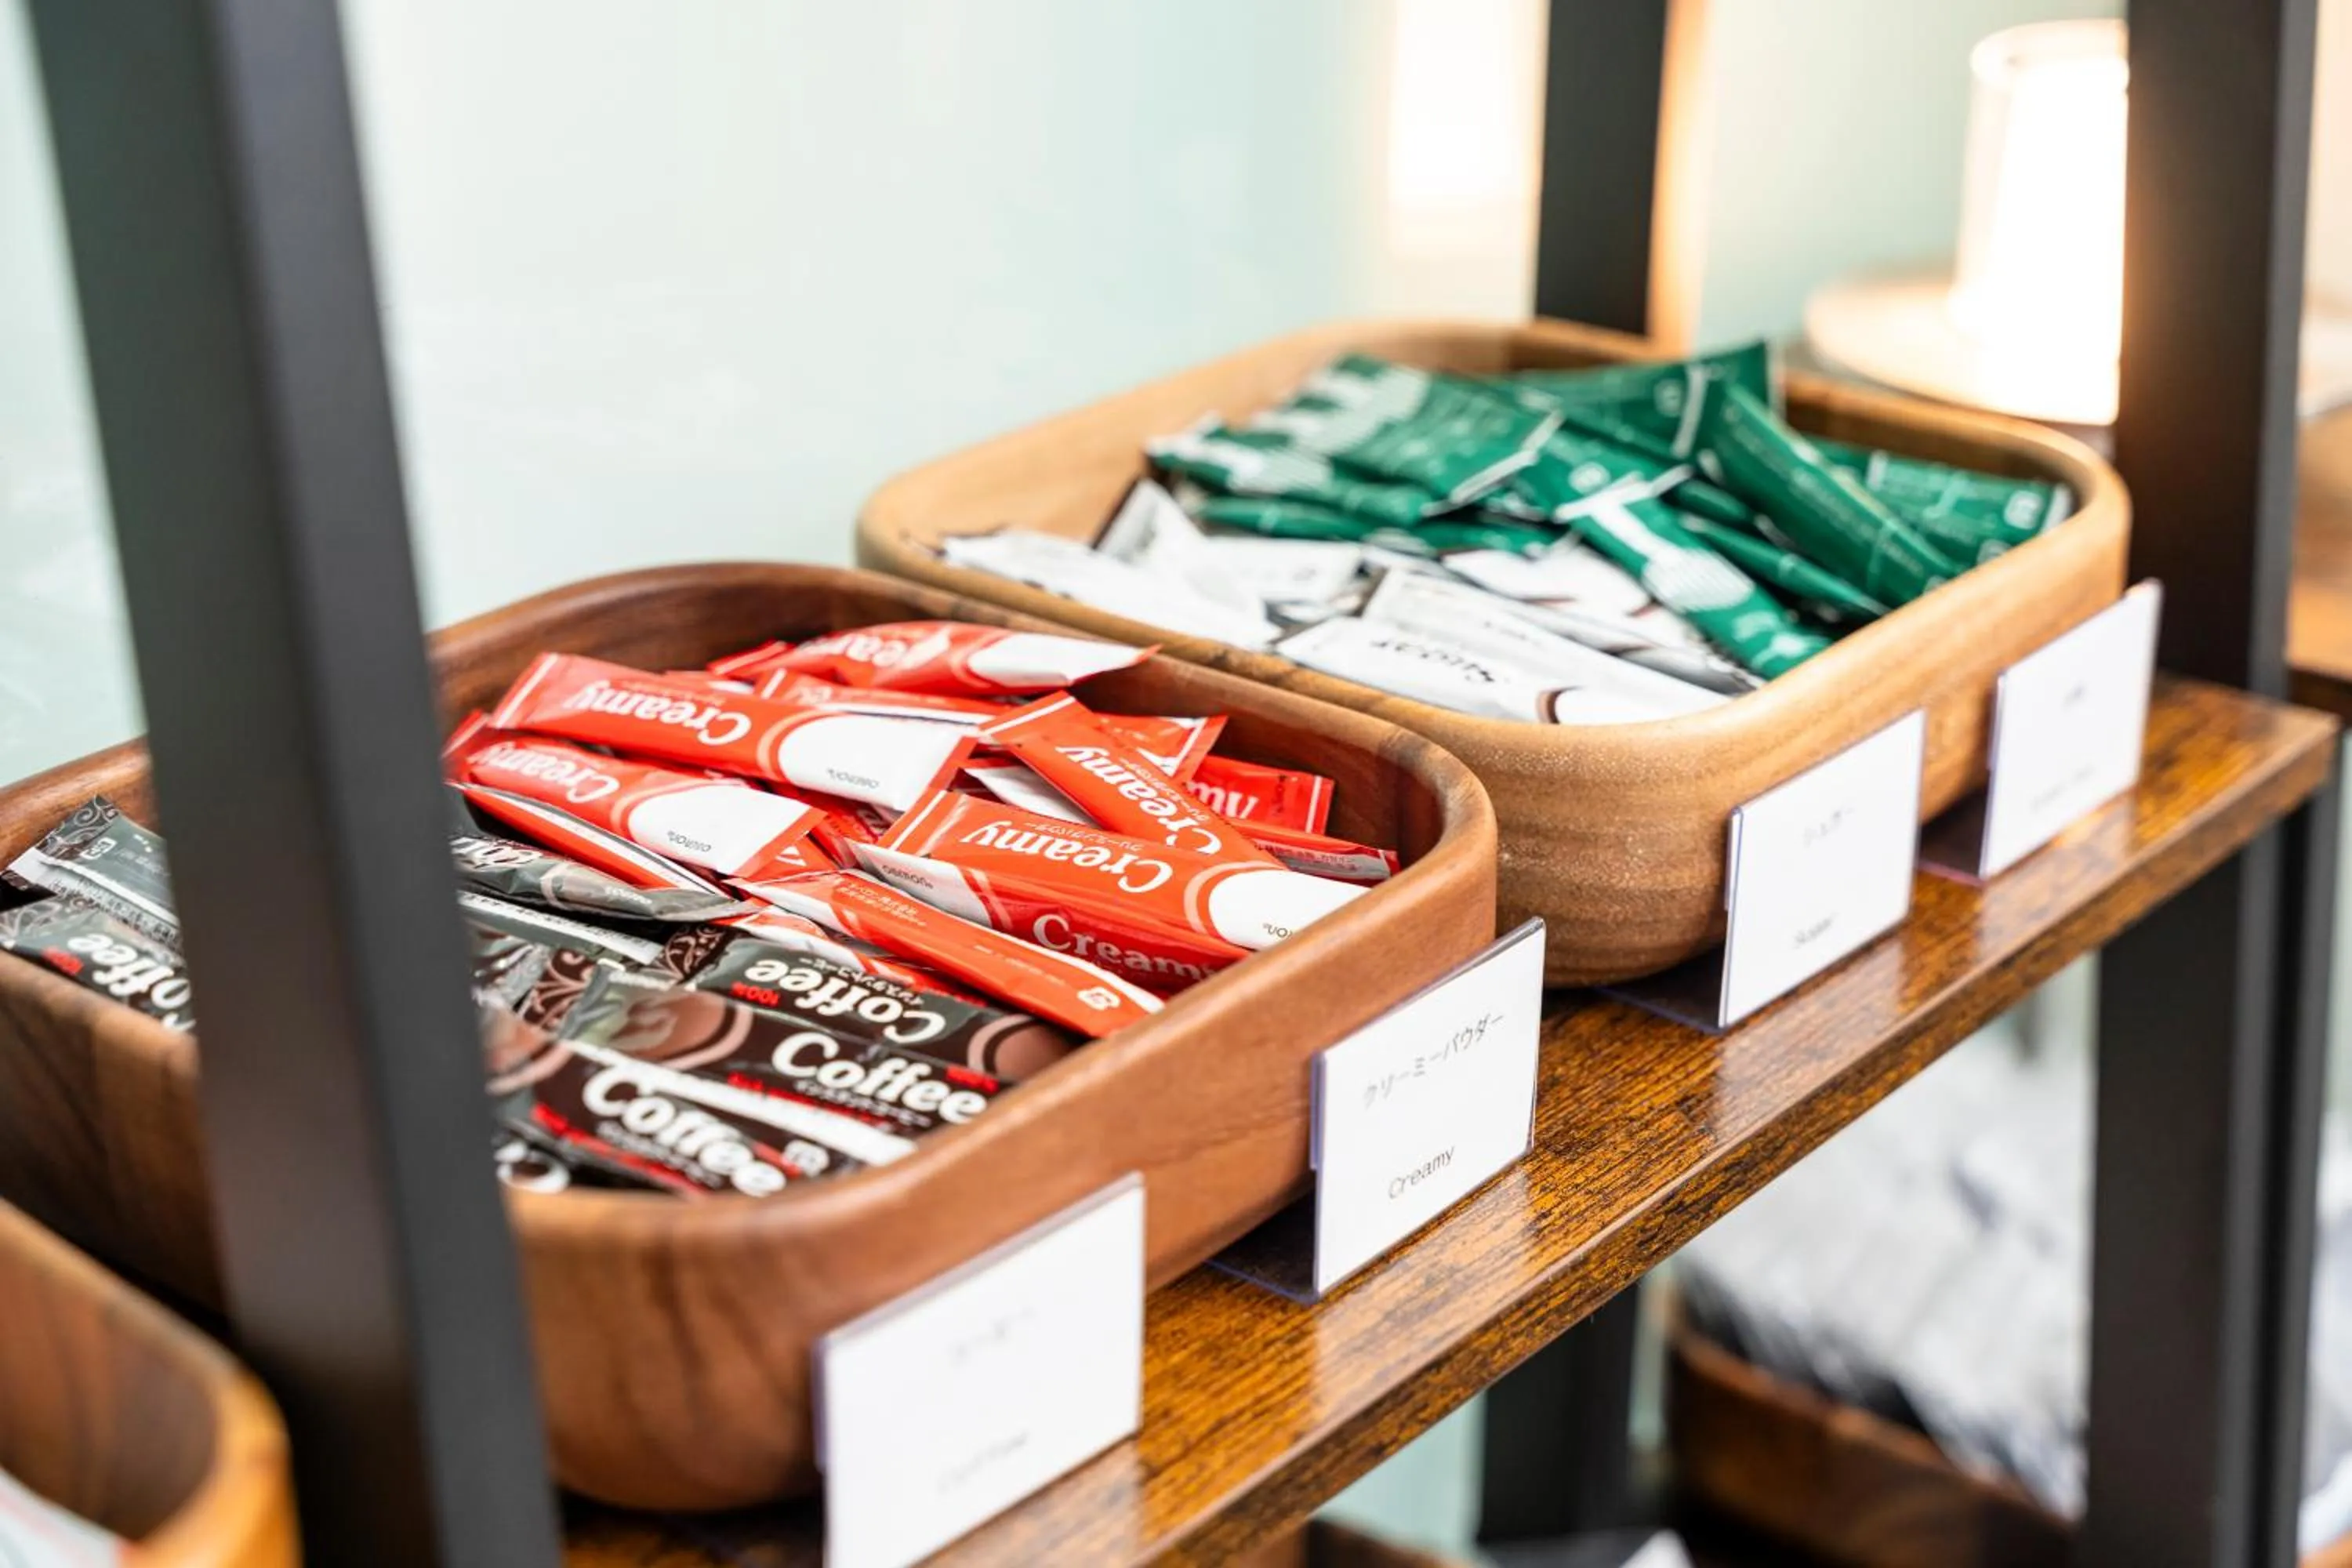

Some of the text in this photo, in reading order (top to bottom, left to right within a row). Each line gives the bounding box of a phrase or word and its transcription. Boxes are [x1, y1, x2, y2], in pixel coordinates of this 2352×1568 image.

[562, 679, 753, 746] Creamy
[466, 740, 621, 804] Creamy
[1054, 746, 1222, 855] Creamy
[958, 820, 1174, 893] Creamy
[744, 959, 946, 1044] Coffee
[771, 1032, 988, 1124] Coffee
[582, 1065, 787, 1197] Coffee
[1387, 1145, 1456, 1200] Creamy
